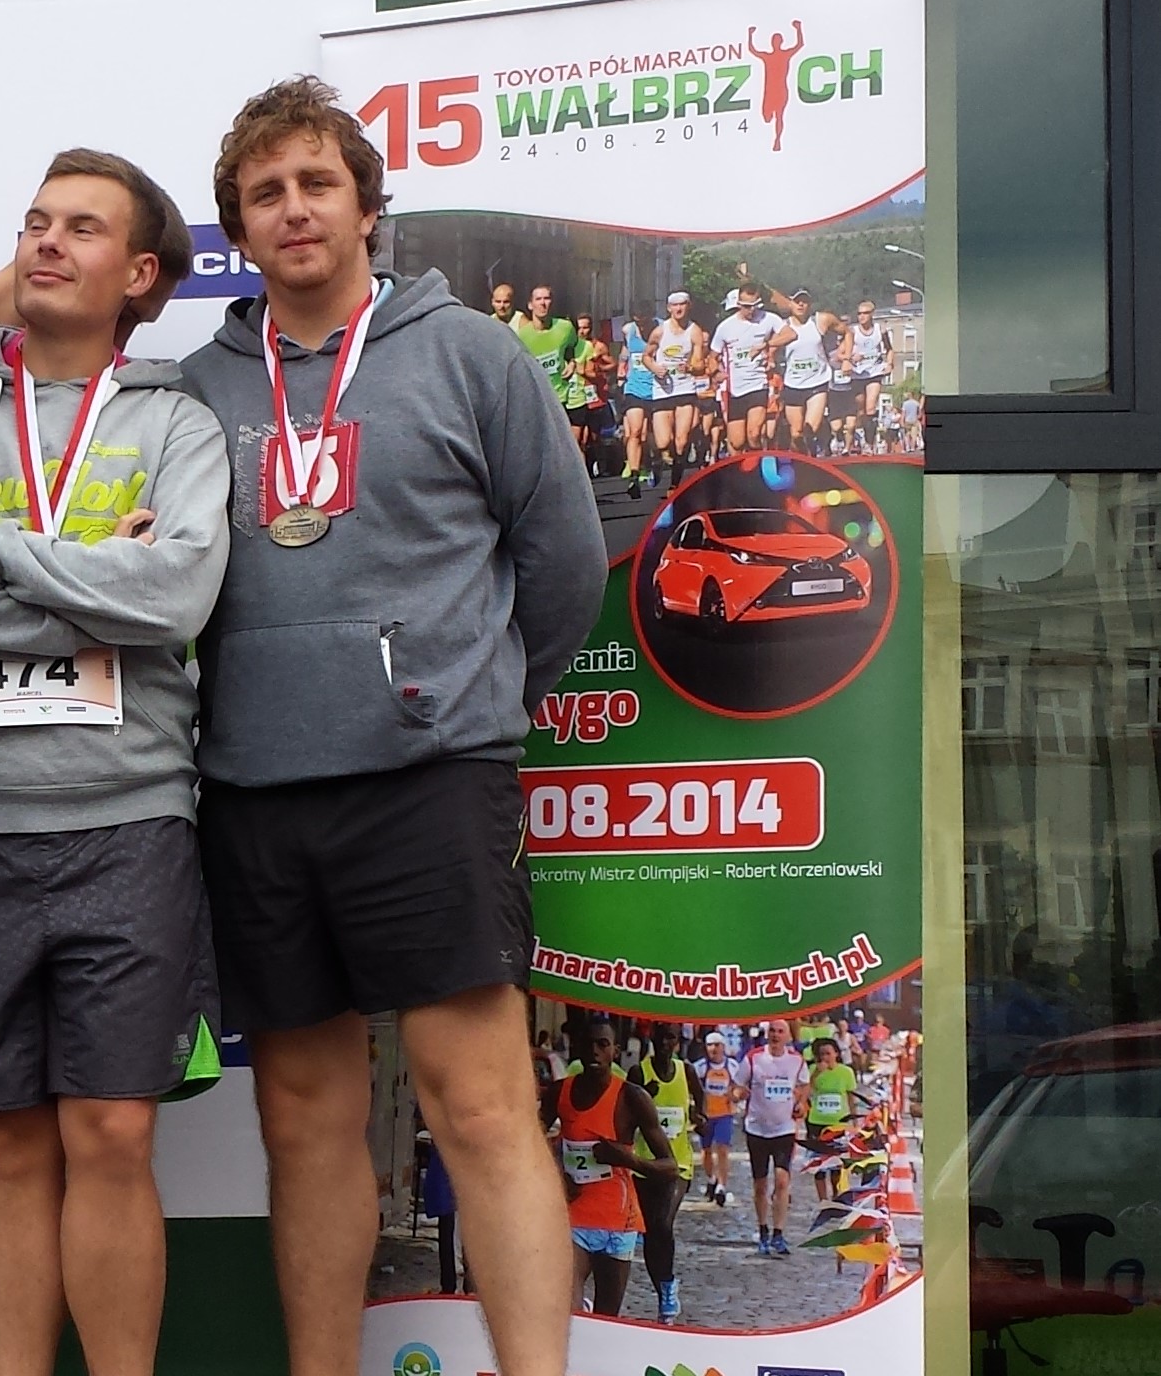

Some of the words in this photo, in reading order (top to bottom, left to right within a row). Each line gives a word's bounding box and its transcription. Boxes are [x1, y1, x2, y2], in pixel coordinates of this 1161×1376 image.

[354, 74, 483, 172] 15
[493, 62, 583, 89] TOYOTA
[589, 42, 743, 79] PÓŁMARATON
[567, 642, 637, 673] ania
[529, 778, 782, 839] 08.2014
[531, 867, 585, 885] okrotny
[589, 866, 635, 882] Mistrz
[638, 865, 709, 884] Olimpijski
[725, 863, 776, 879] Robert
[780, 860, 882, 878] Korzeniowski
[575, 1155, 588, 1170] 2
